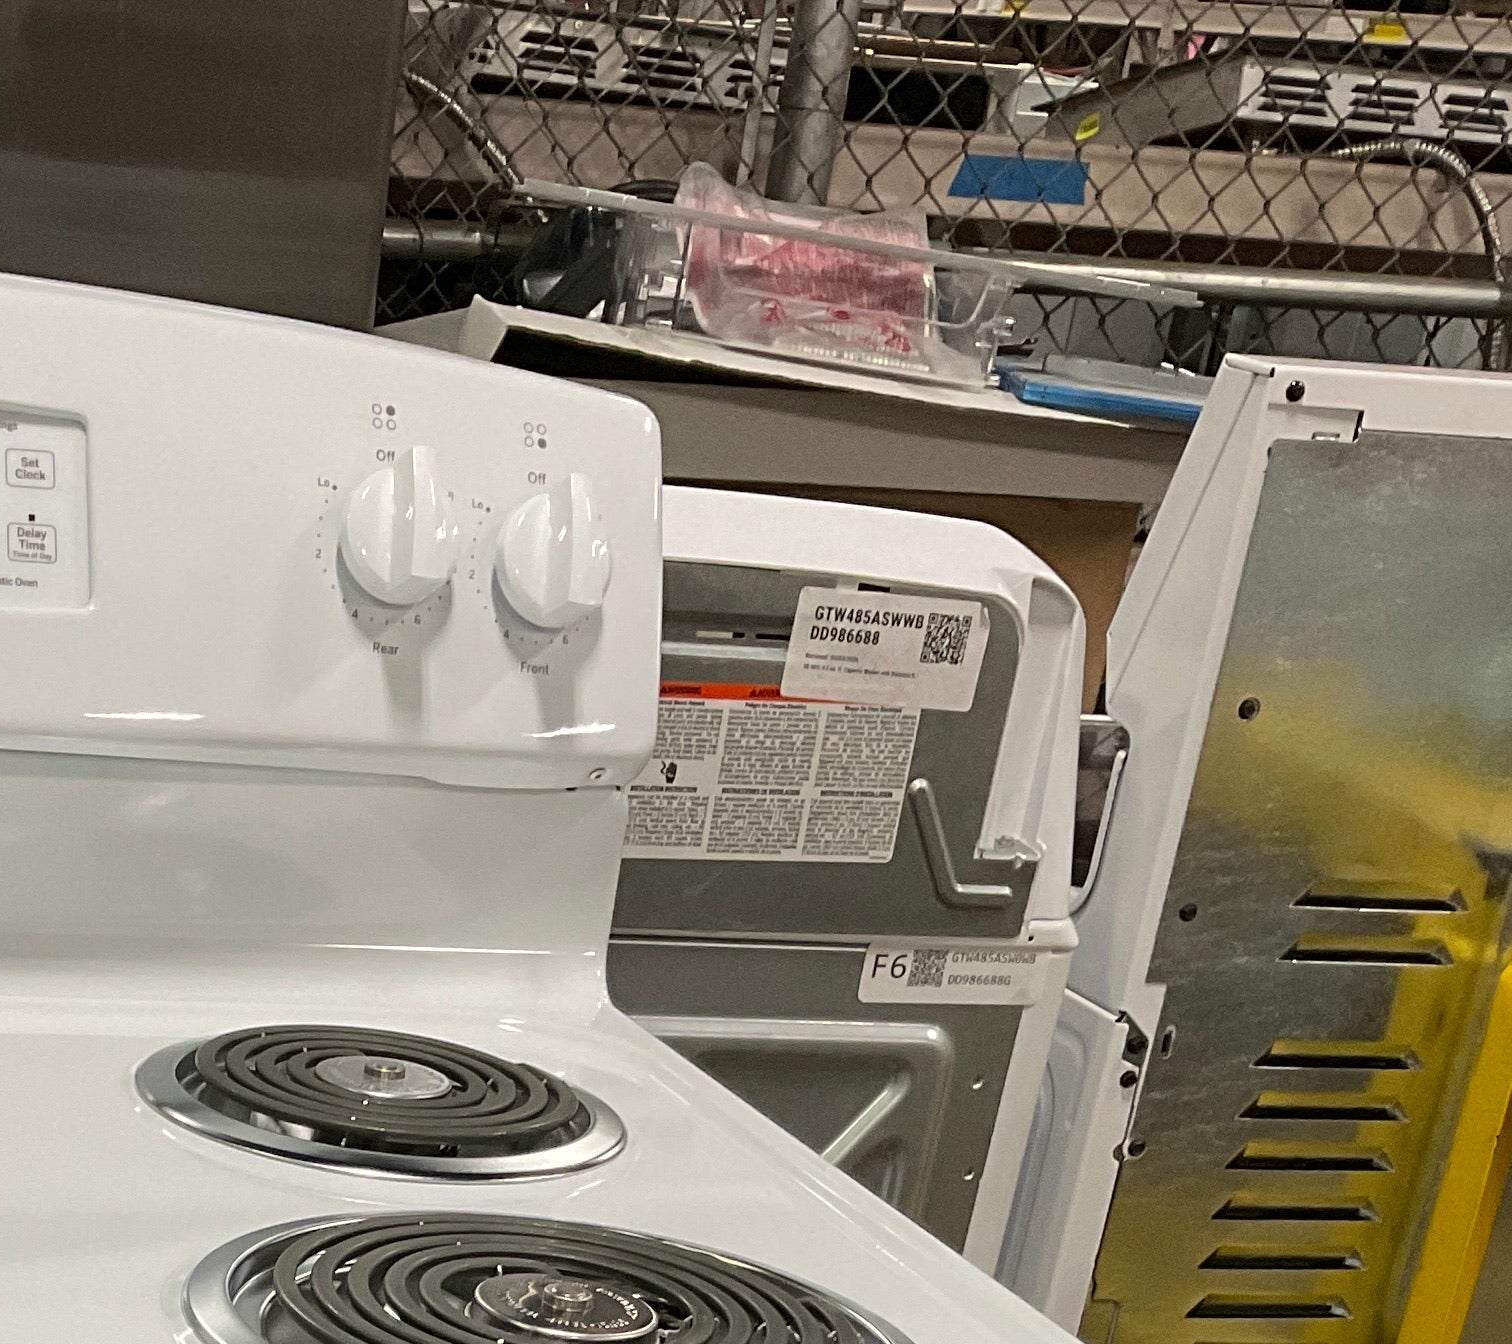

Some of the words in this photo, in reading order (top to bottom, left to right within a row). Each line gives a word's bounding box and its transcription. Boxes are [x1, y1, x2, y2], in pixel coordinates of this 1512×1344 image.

[376, 449, 395, 462] Off
[20, 456, 40, 469] Set
[15, 468, 46, 481] Clock
[527, 471, 546, 484] Off
[317, 476, 330, 488] Lo
[472, 499, 484, 509] Lo
[17, 526, 47, 541] Delay
[19, 539, 46, 551] Time
[315, 548, 322, 559] 2
[469, 569, 475, 580] 2
[14, 577, 39, 588] Oven
[351, 608, 359, 619] 4
[414, 614, 421, 625] 6
[815, 606, 925, 629] GTW485ASWWB
[503, 629, 510, 641] 4
[562, 635, 569, 646] 6
[810, 625, 880, 646] DD986688
[372, 642, 400, 655] Rear
[520, 661, 549, 676] Front
[871, 953, 909, 979] F6
